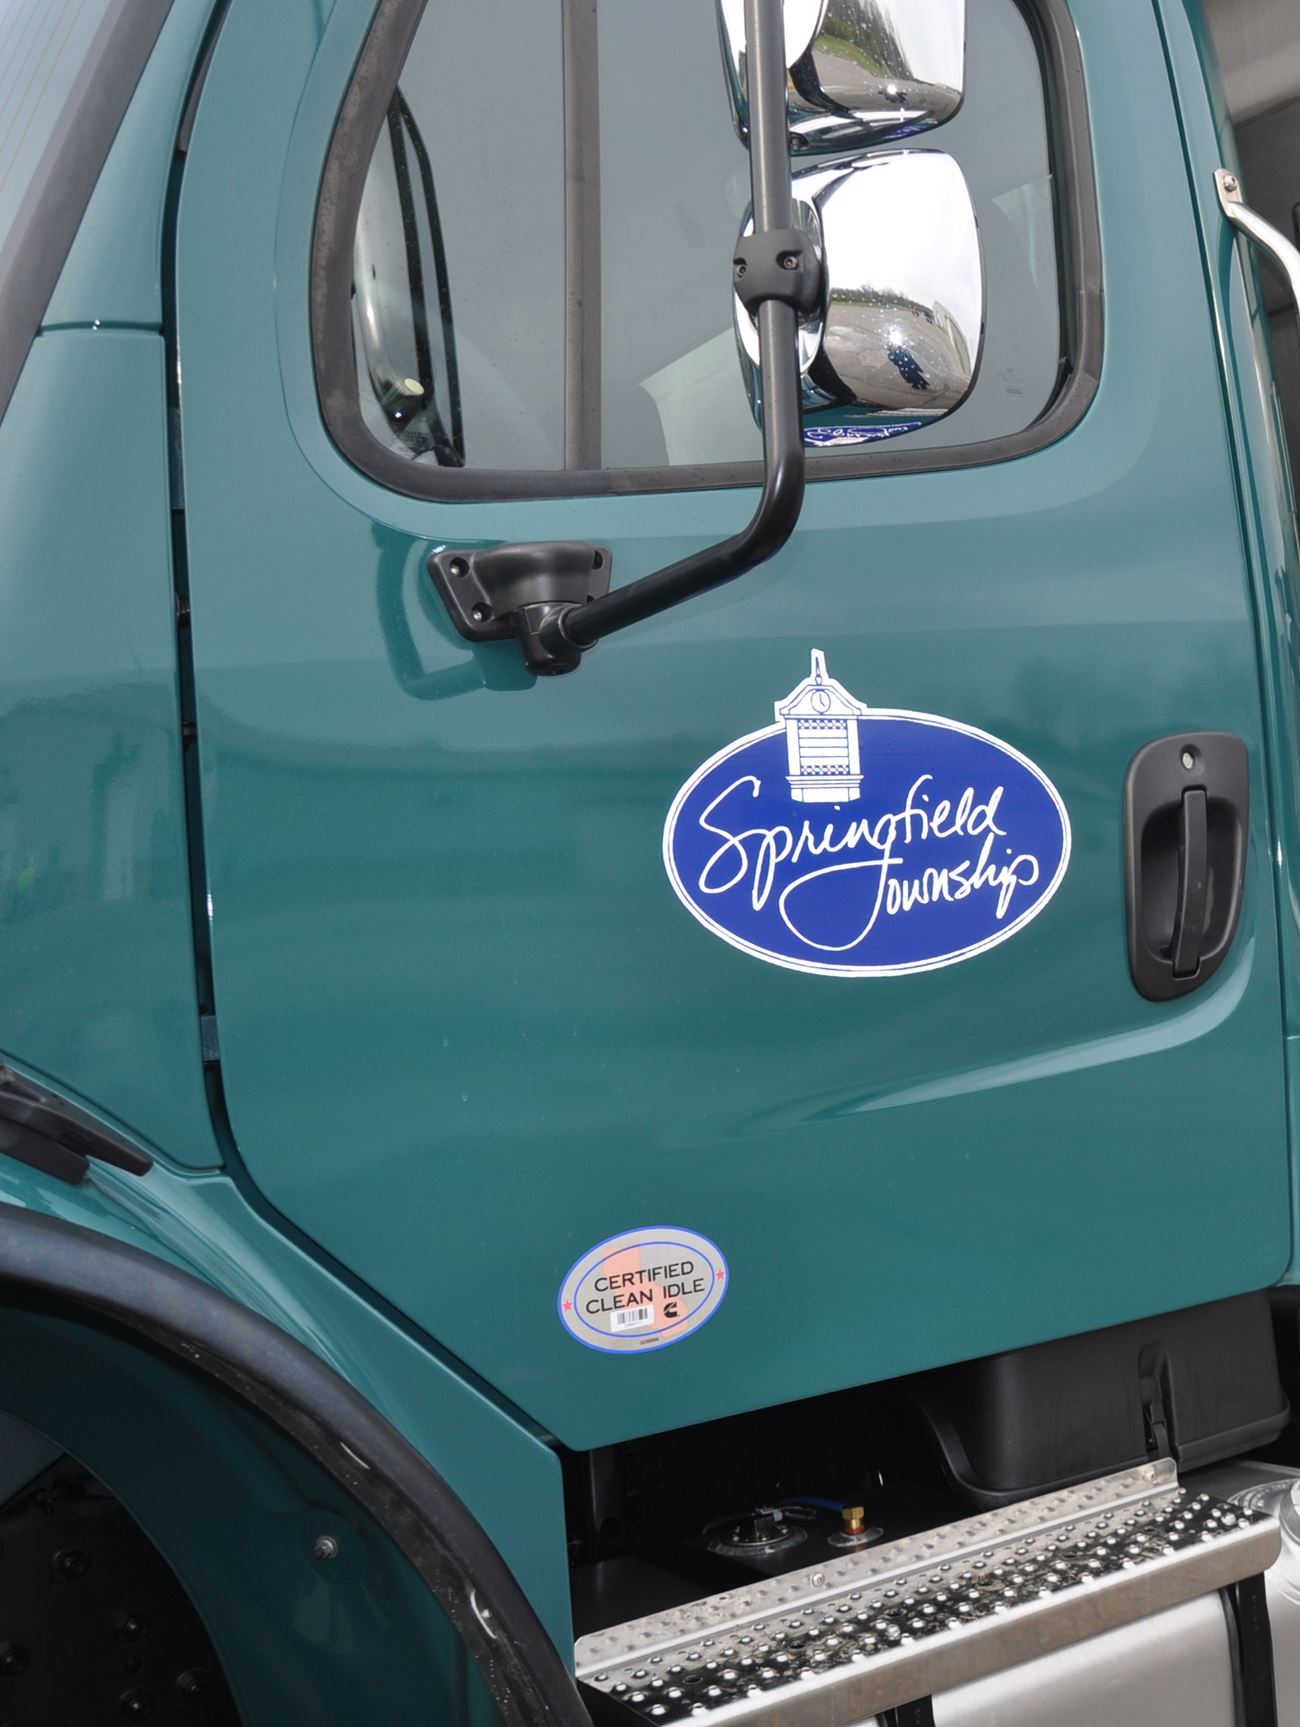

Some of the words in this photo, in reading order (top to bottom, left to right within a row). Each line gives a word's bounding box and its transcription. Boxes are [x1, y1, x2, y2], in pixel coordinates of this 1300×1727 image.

[697, 774, 1007, 911] Springfield
[778, 831, 1040, 951] Township
[585, 1288, 654, 1315] CLEAN
[663, 1278, 705, 1299] IDLE
[594, 1260, 694, 1293] CERTIFIED
